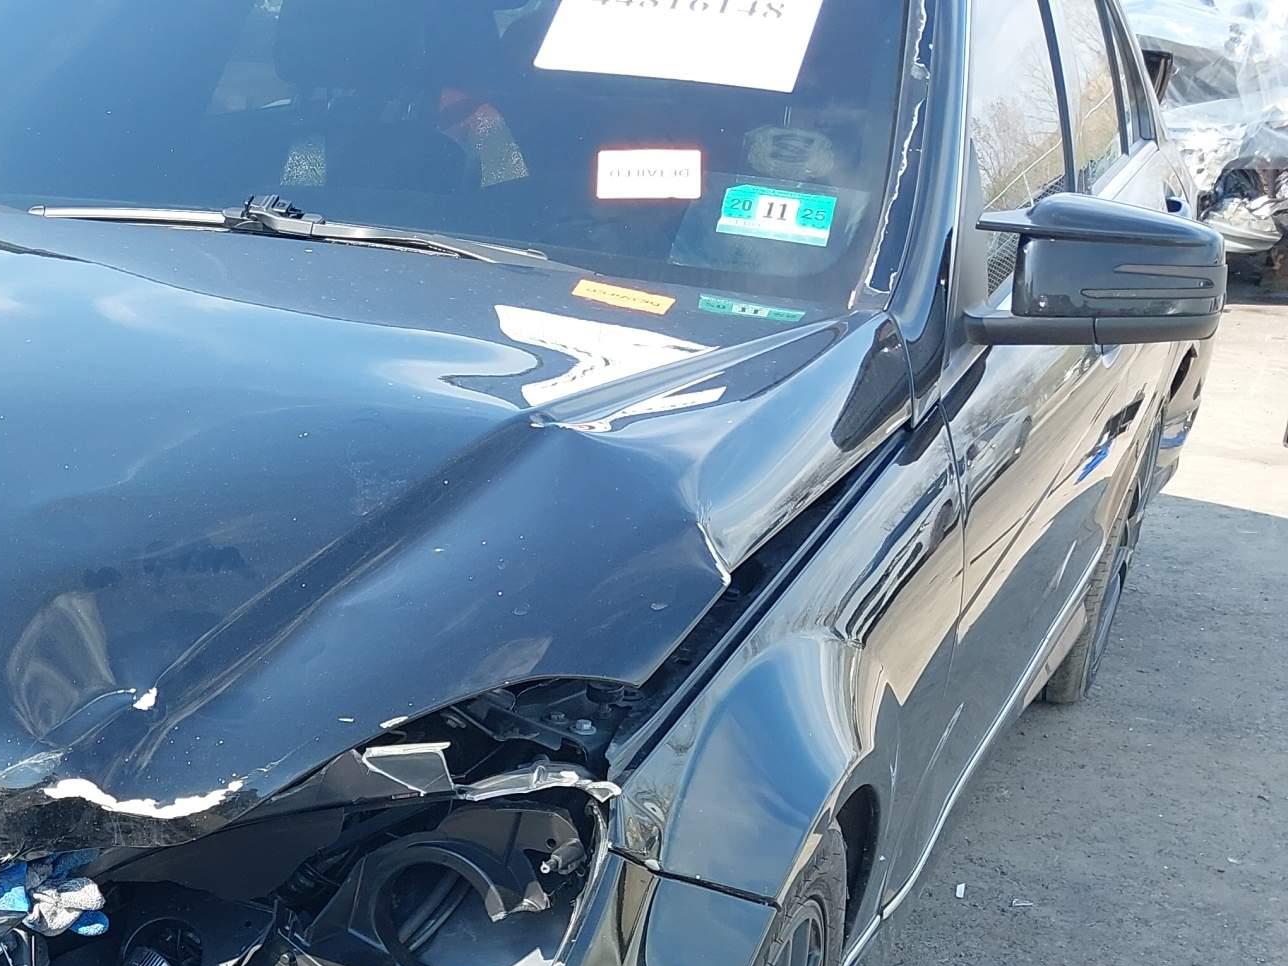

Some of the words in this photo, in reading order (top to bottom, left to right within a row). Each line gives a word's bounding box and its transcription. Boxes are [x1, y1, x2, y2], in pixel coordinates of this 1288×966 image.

[730, 198, 753, 212] 20
[762, 201, 788, 221] 11
[800, 207, 826, 221] 25
